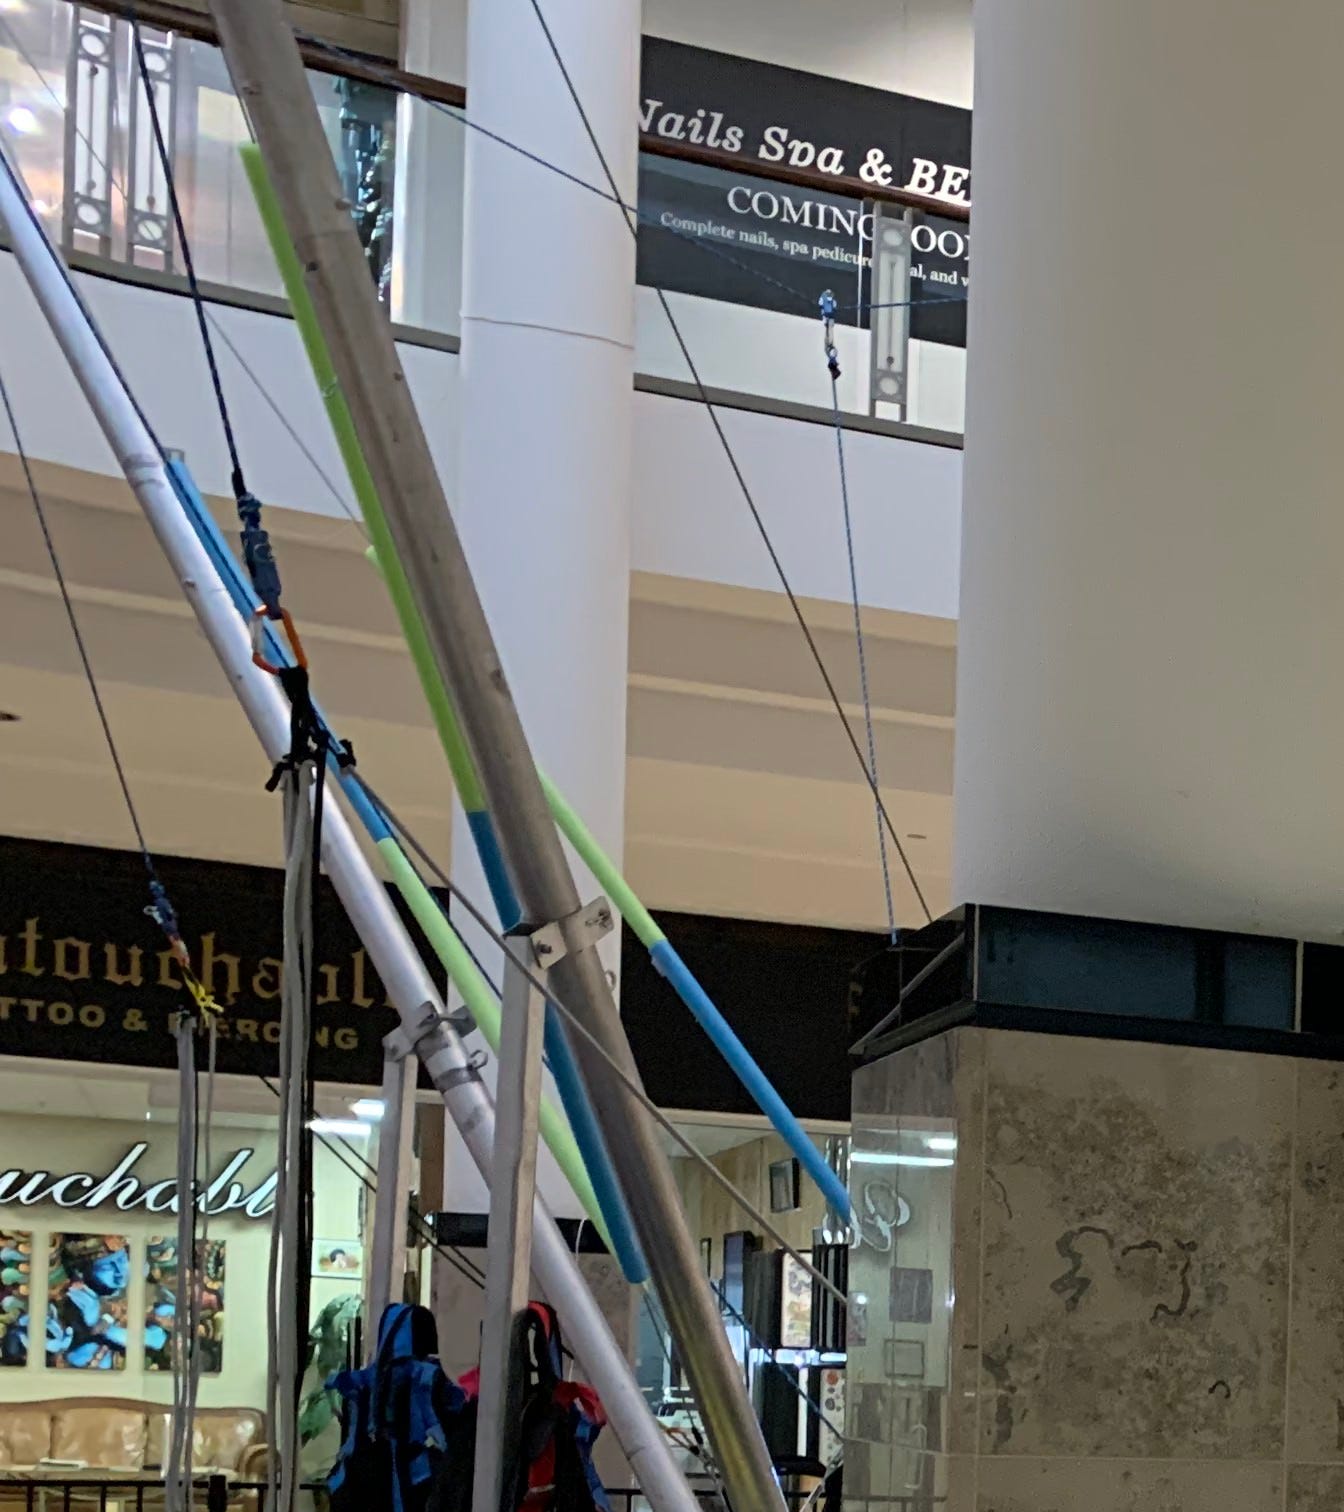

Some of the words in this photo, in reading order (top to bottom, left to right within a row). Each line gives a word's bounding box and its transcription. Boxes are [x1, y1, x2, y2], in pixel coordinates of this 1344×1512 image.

[639, 99, 744, 152] Nails
[758, 126, 845, 175] Spa
[859, 148, 892, 186] &
[660, 212, 736, 239] Complete
[739, 230, 779, 250] nails,
[783, 240, 809, 255] spa
[930, 270, 957, 285] and
[123, 1008, 148, 1031] &
